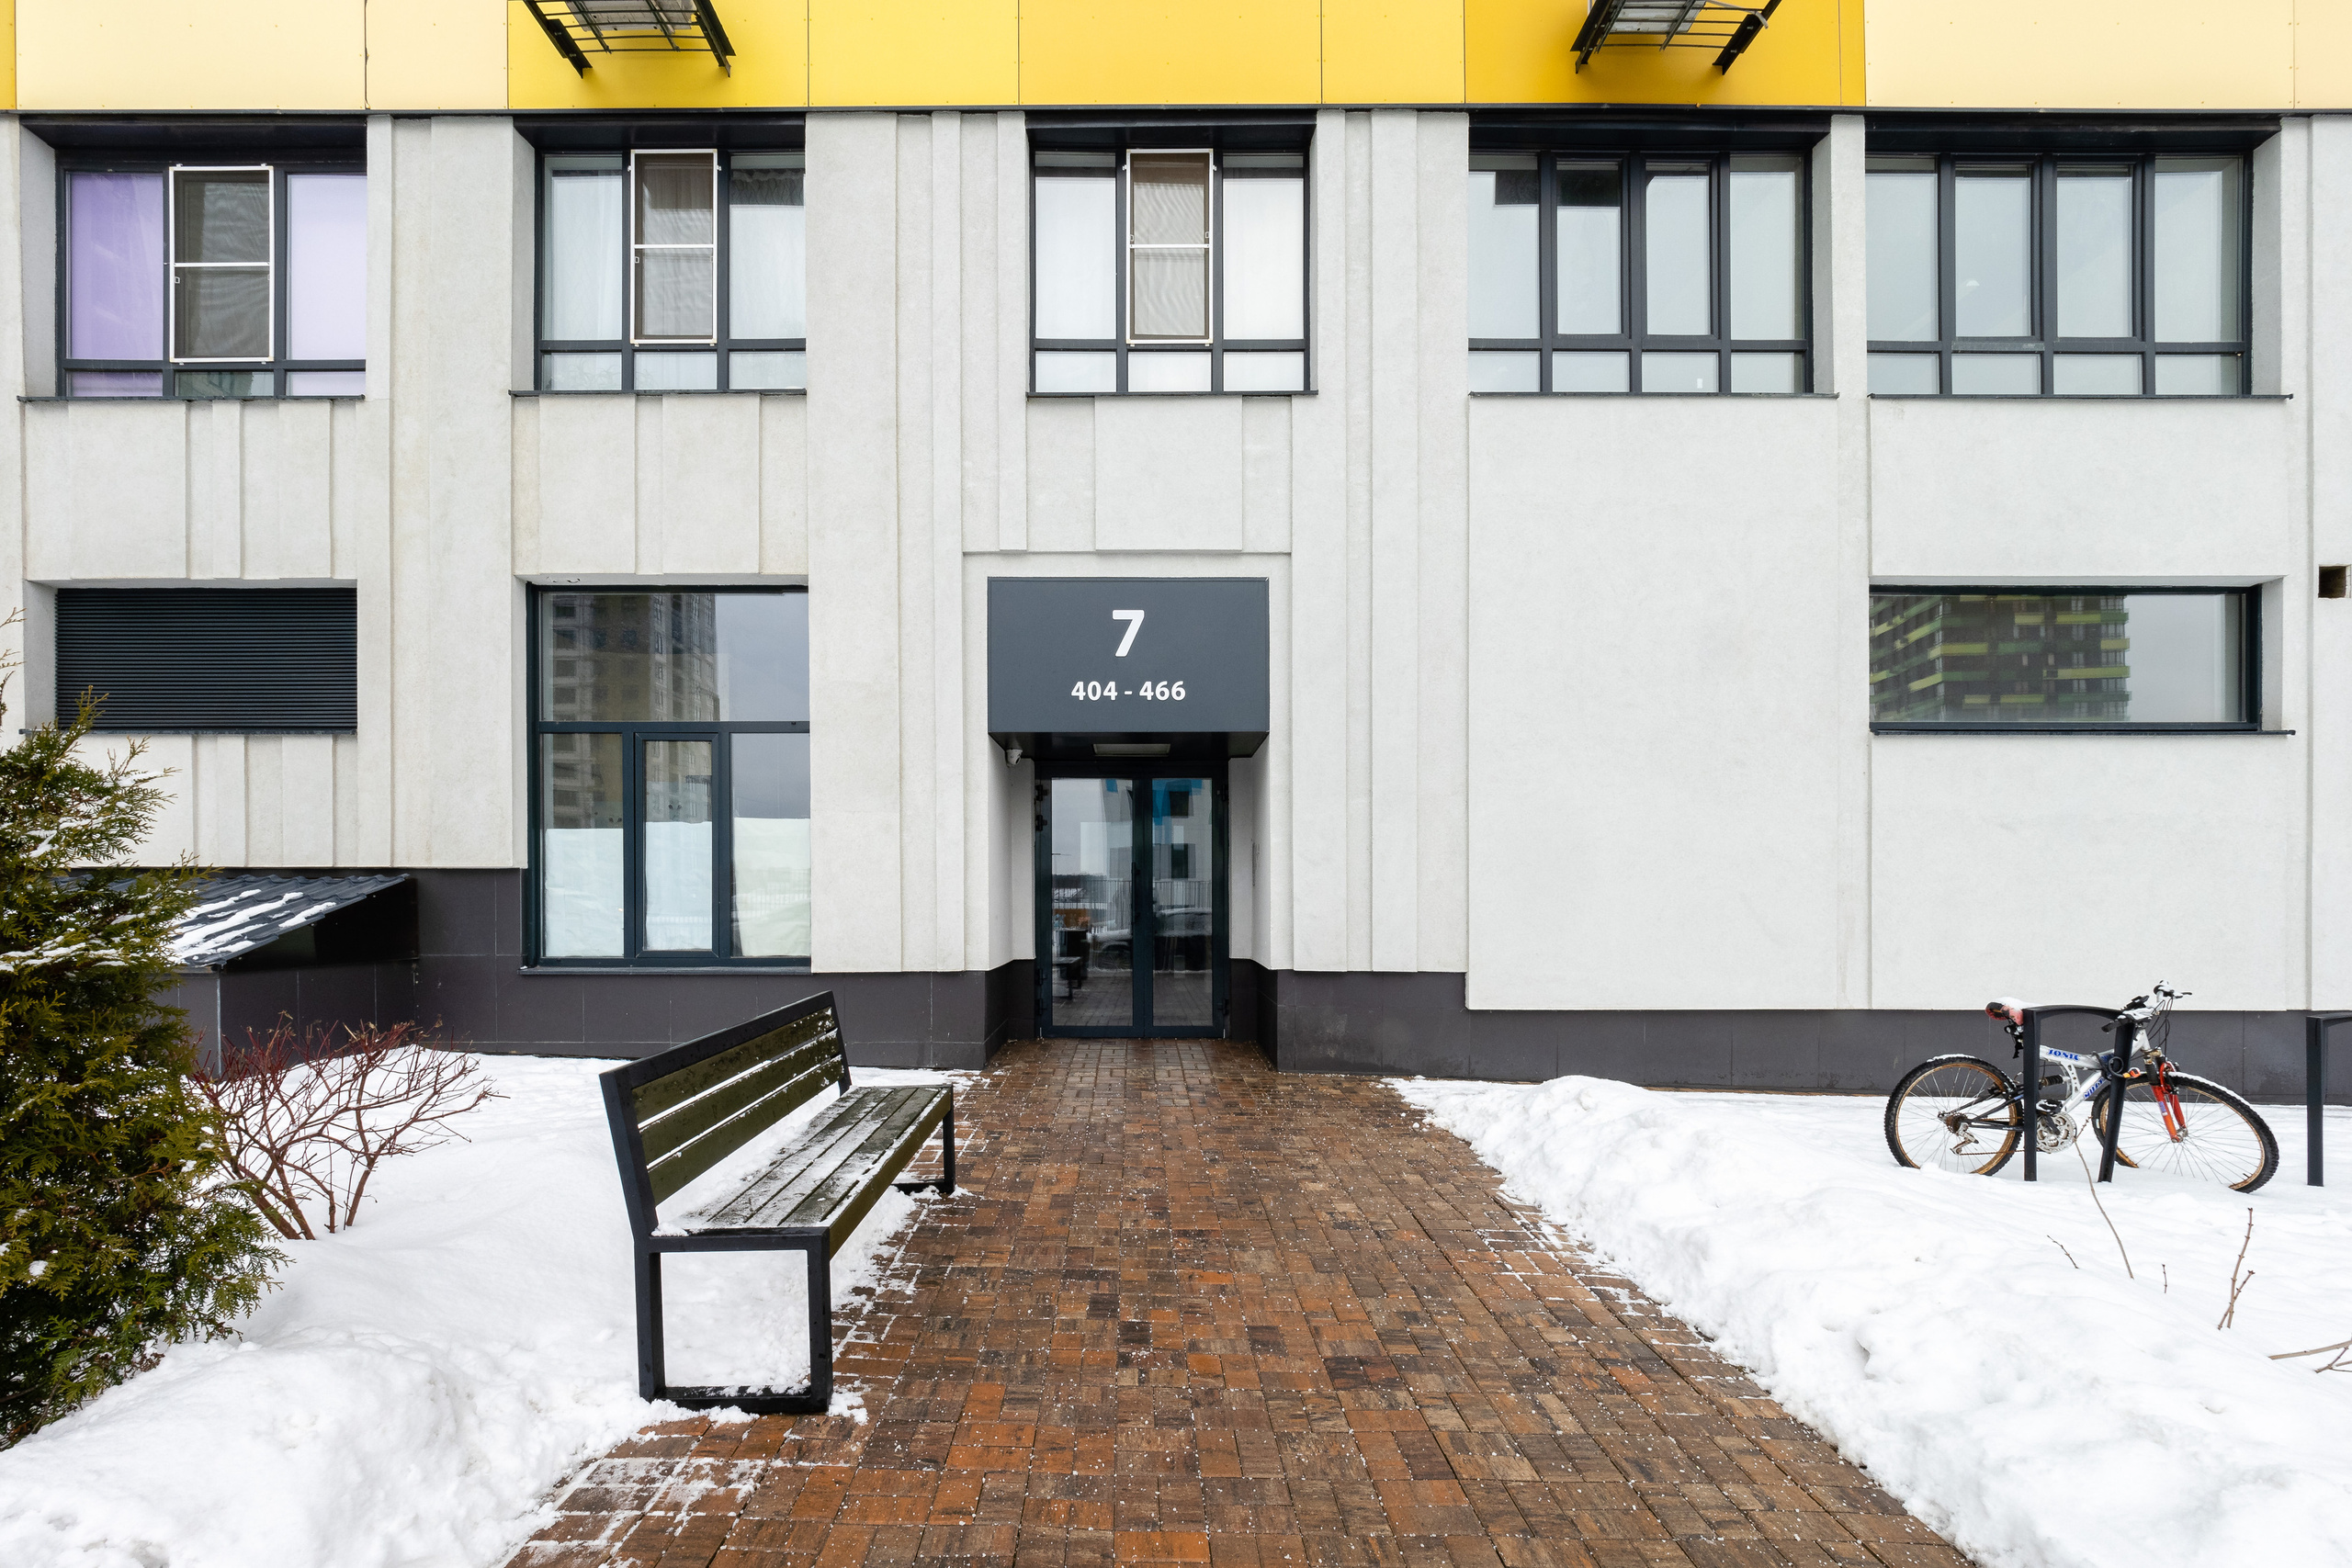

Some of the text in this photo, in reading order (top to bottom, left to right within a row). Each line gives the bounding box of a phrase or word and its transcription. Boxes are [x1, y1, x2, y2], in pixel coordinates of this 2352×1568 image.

[1112, 609, 1145, 658] 7
[1070, 681, 1118, 701] 404
[1138, 680, 1186, 701] 466
